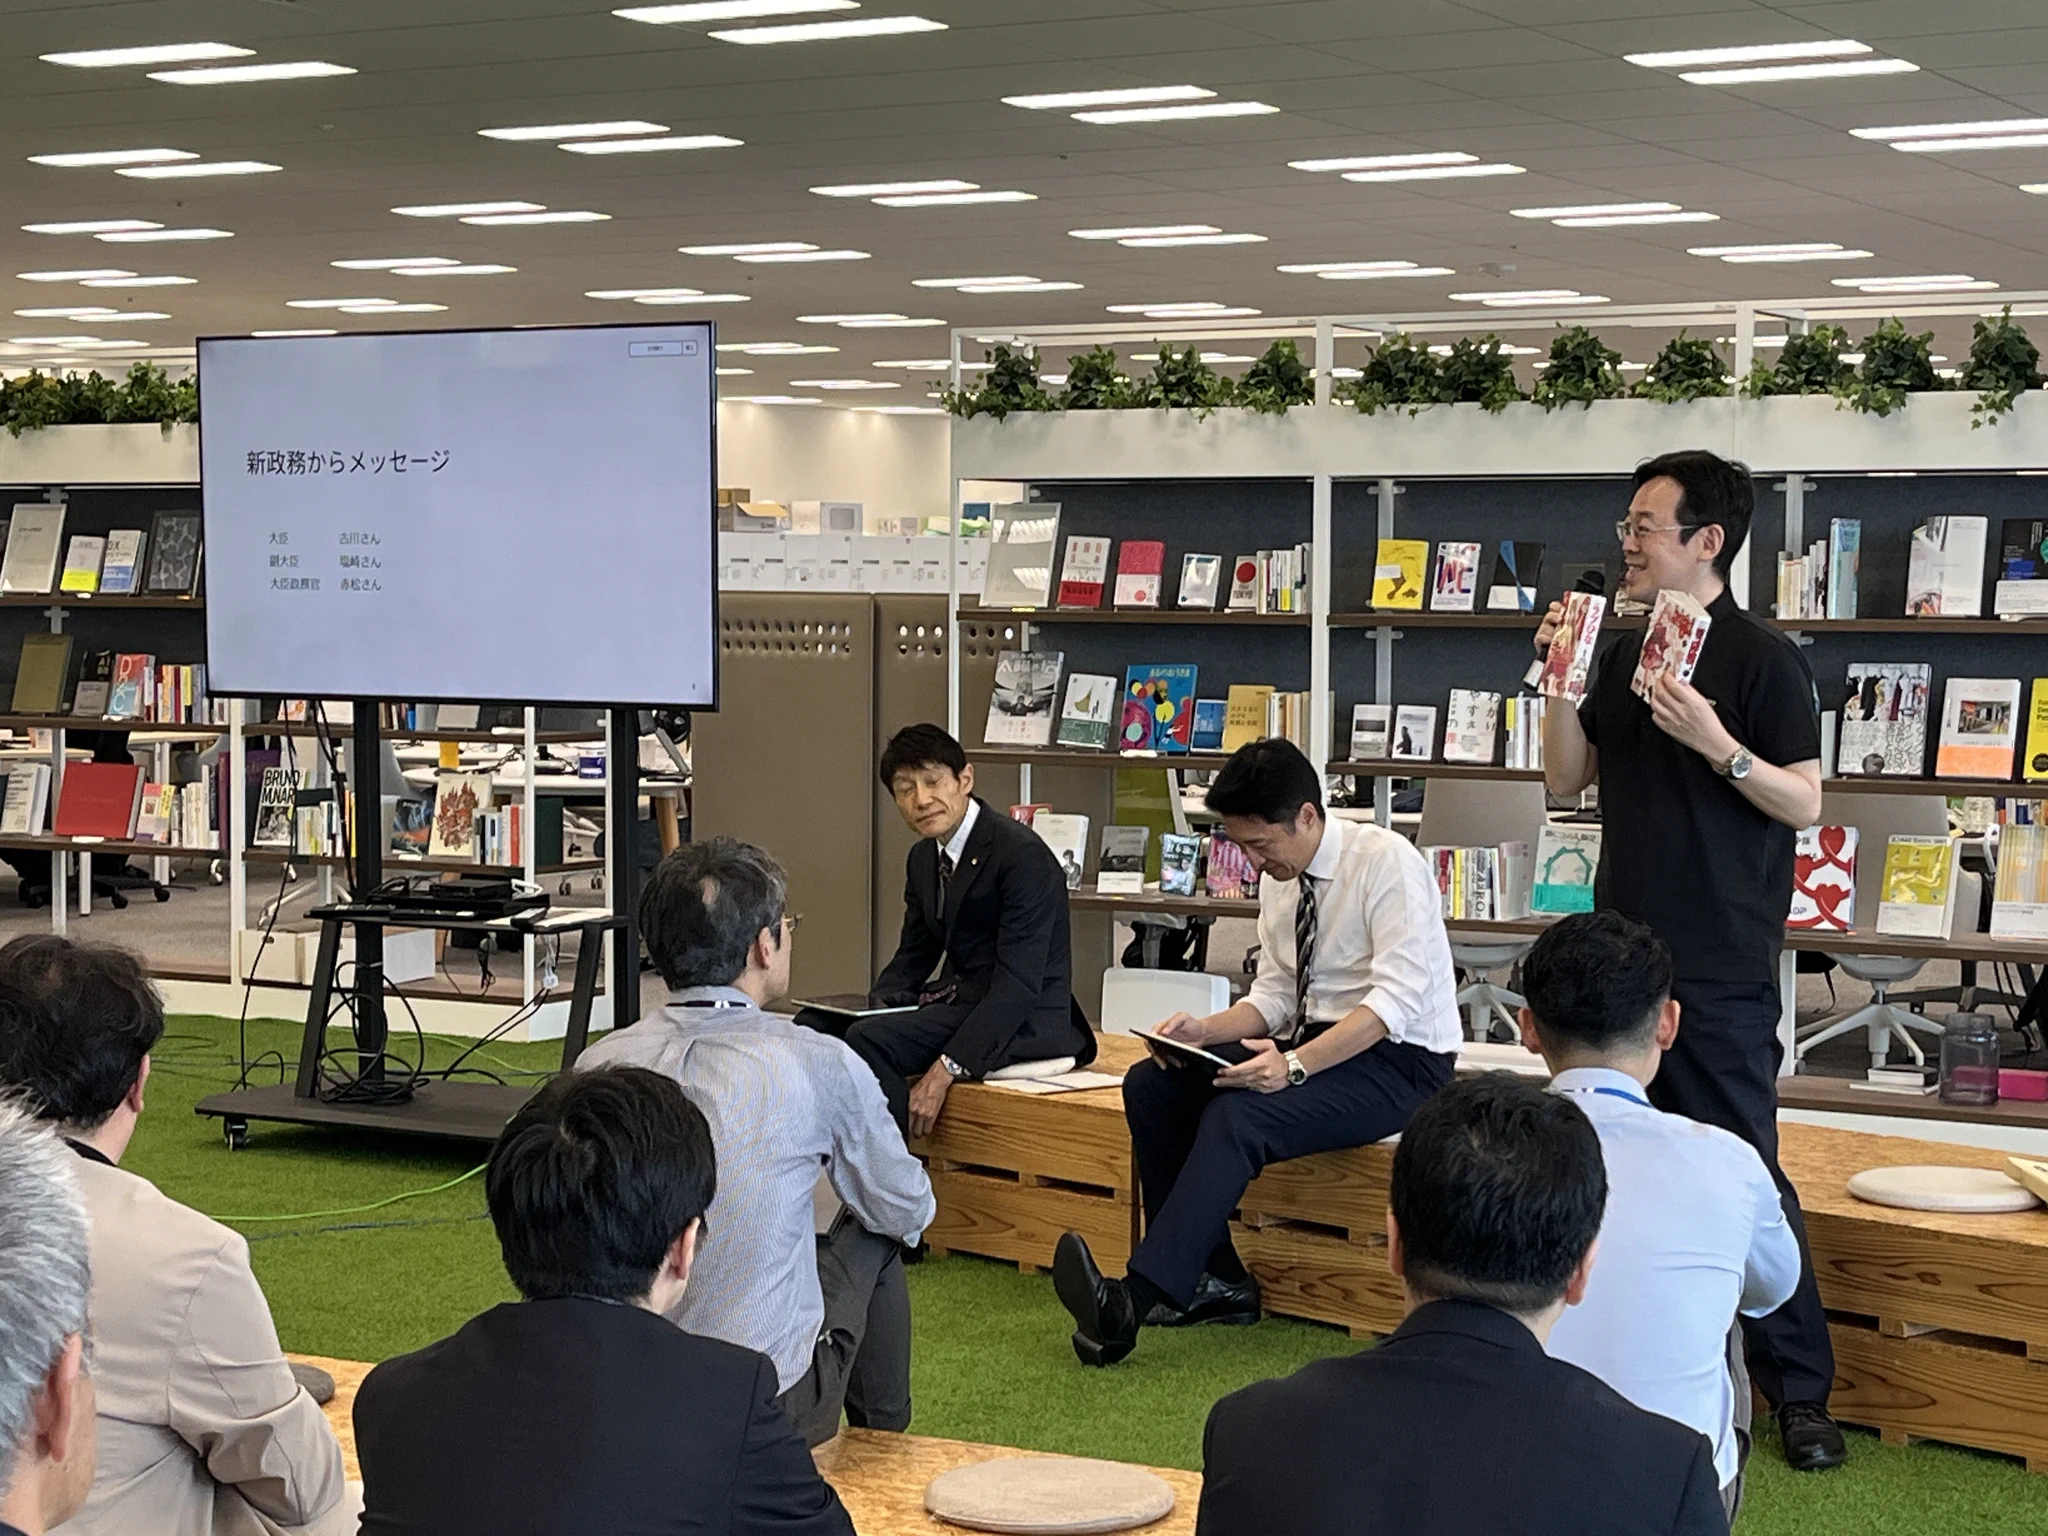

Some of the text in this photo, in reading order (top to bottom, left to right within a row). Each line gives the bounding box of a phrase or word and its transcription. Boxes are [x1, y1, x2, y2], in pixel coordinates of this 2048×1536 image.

[247, 450, 450, 475] 新政務からメッセージ
[269, 532, 289, 545] 大臣
[269, 555, 299, 568] 副大臣
[270, 578, 320, 590] 大臣政務官
[265, 769, 300, 787] BRUNO
[261, 788, 298, 804] MUNAR
